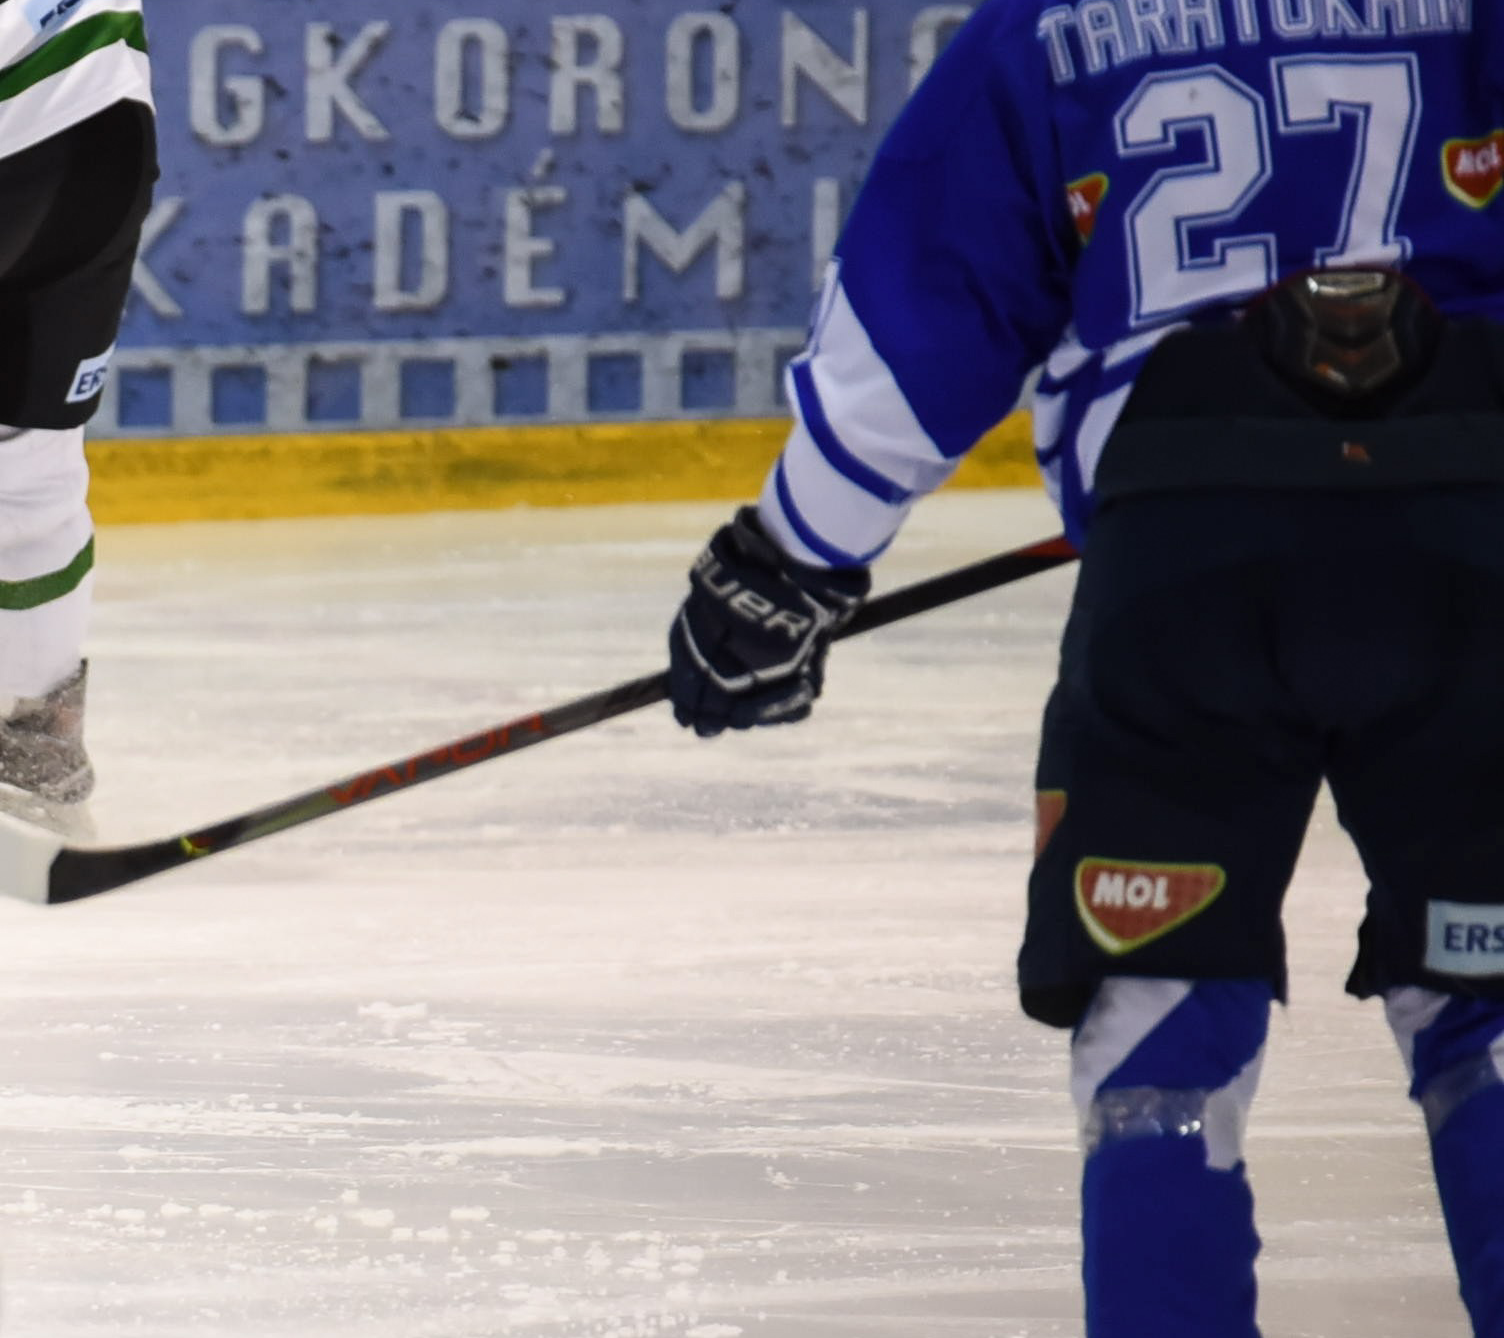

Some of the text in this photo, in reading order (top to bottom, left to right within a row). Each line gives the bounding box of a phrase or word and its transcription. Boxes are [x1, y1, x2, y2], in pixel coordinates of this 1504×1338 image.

[189, 4, 976, 147] GKORON
[124, 148, 840, 320] KADÉMI
[1113, 51, 1424, 329] 27
[695, 547, 813, 639] UER
[1092, 871, 1172, 910] MOL
